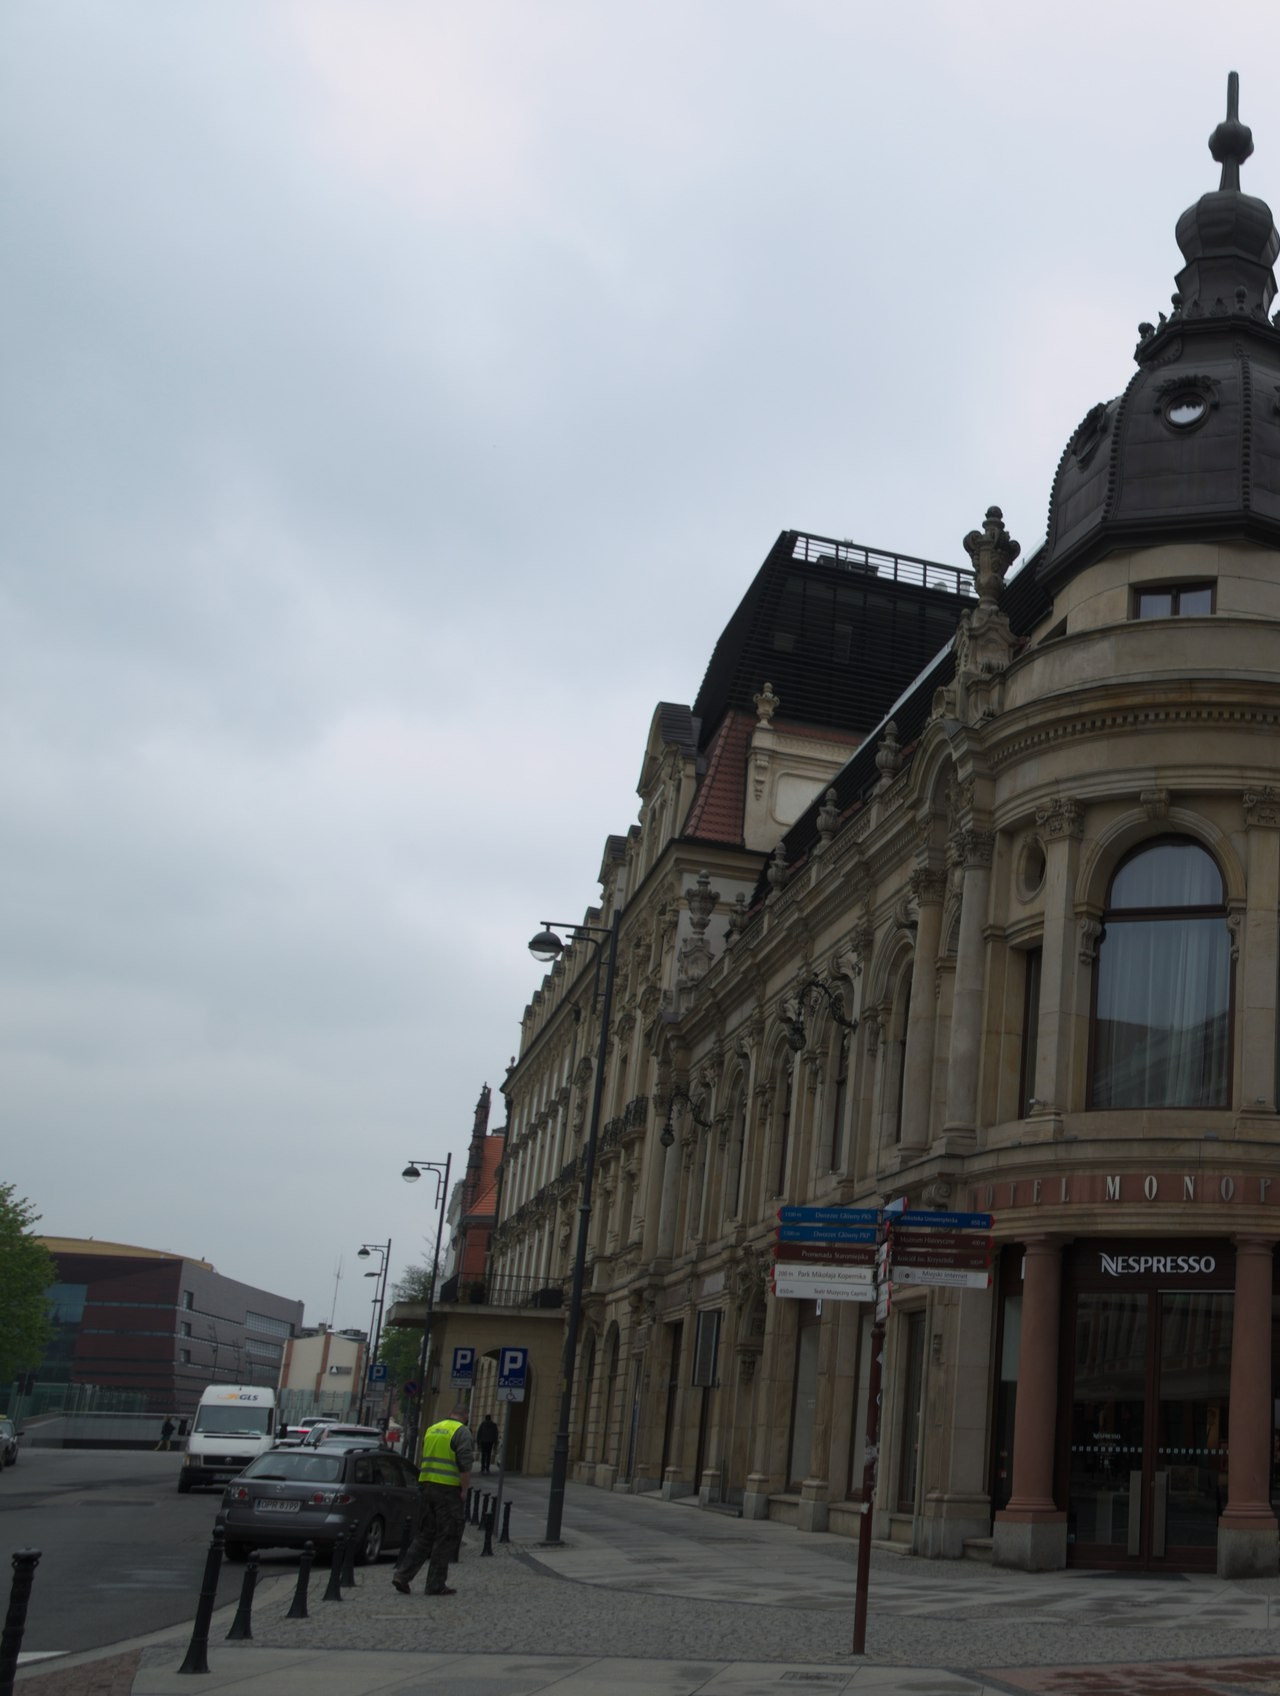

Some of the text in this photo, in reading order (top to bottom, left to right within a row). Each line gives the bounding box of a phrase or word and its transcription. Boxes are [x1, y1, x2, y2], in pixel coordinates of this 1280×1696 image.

[801, 1250, 832, 1258] Promenada
[1097, 1252, 1217, 1278] NESPRESSO
[811, 1272, 836, 1280] Mikołaja
[838, 1272, 866, 1280] Kopernika
[922, 1270, 943, 1278] Miejski
[456, 1350, 472, 1370] P
[503, 1350, 523, 1376] P
[373, 1366, 383, 1380] P
